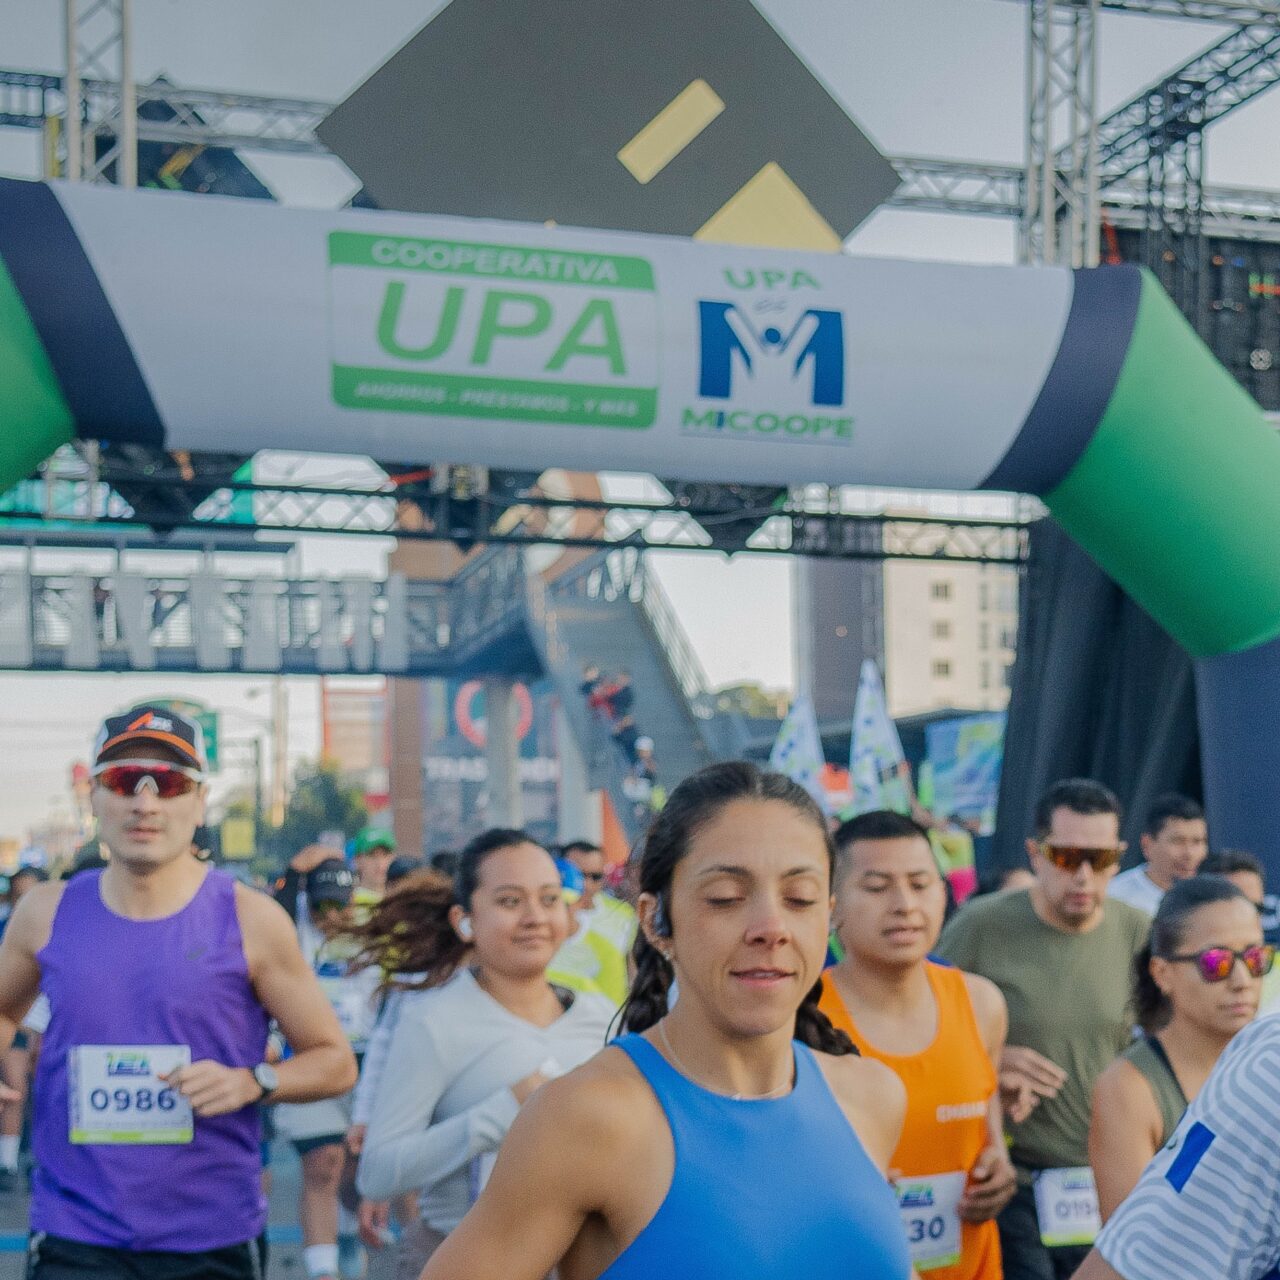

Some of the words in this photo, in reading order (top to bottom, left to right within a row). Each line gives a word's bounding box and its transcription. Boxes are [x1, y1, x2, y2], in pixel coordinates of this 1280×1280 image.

[371, 238, 619, 284] COOPERATIVA
[722, 267, 823, 291] UPA
[377, 280, 628, 376] UPA
[680, 406, 855, 440] MICOOPE
[90, 1087, 176, 1112] 0986
[908, 1215, 946, 1243] 30
